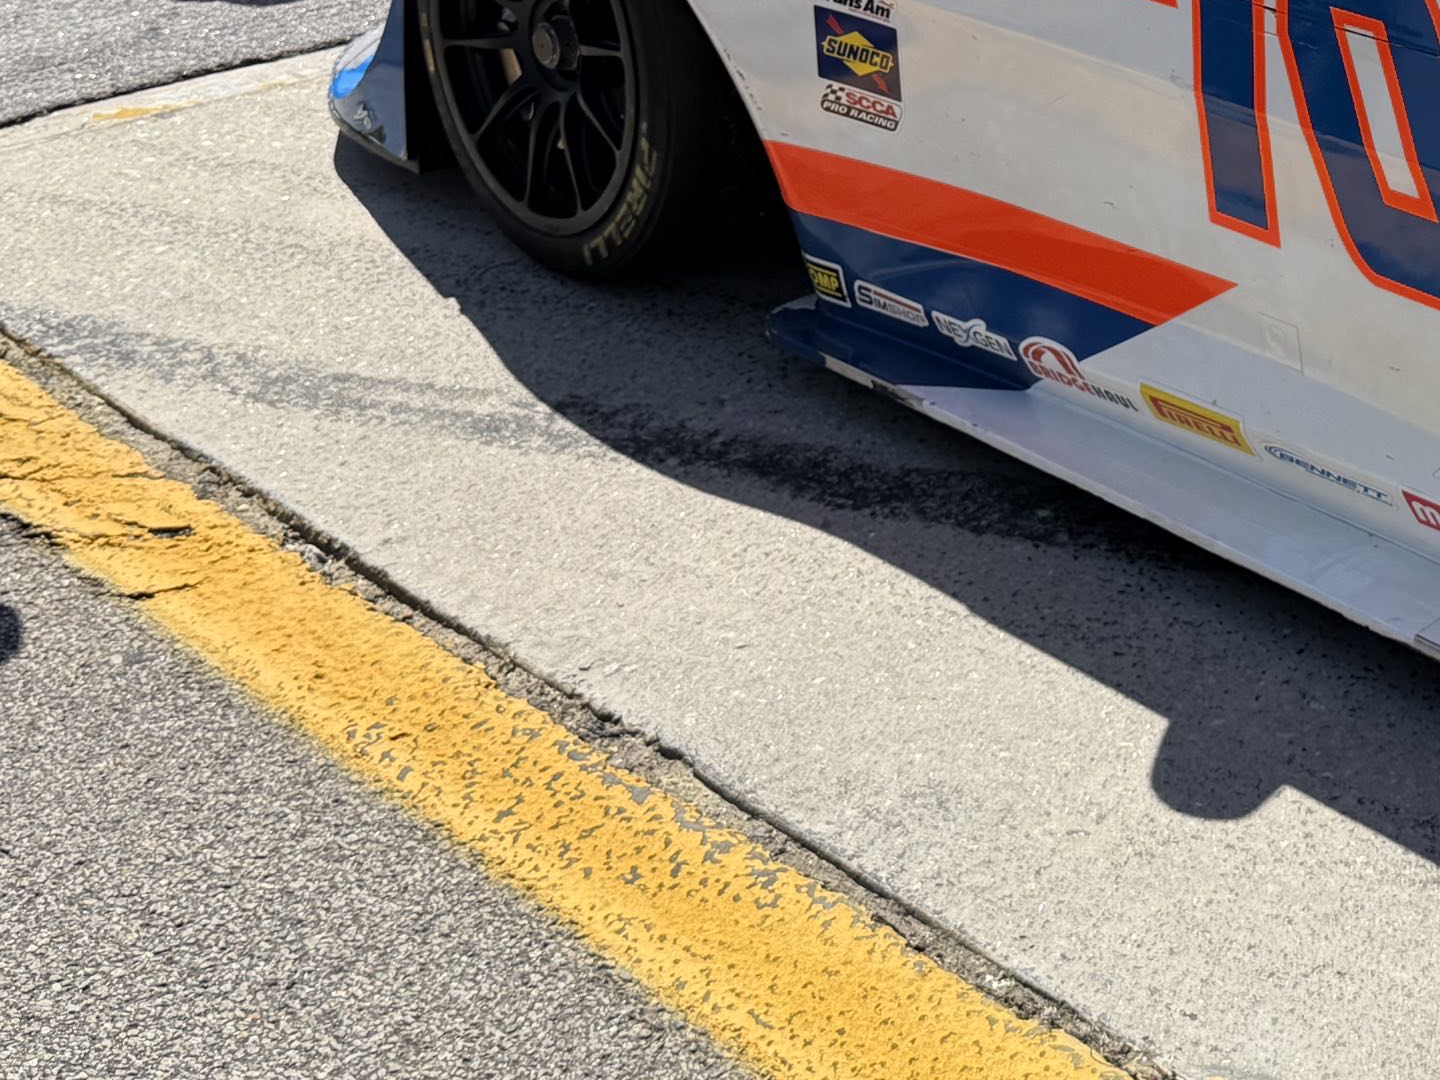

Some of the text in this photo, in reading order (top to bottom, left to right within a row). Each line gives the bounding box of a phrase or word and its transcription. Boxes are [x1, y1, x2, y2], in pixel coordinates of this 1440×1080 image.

[825, 37, 891, 70] SUNOCO
[822, 100, 897, 130] PRO RACING
[844, 91, 898, 119] SCCA
[808, 268, 839, 291] OMP
[1148, 394, 1242, 447] PIRELLI
[1278, 451, 1388, 500] BENNETT
